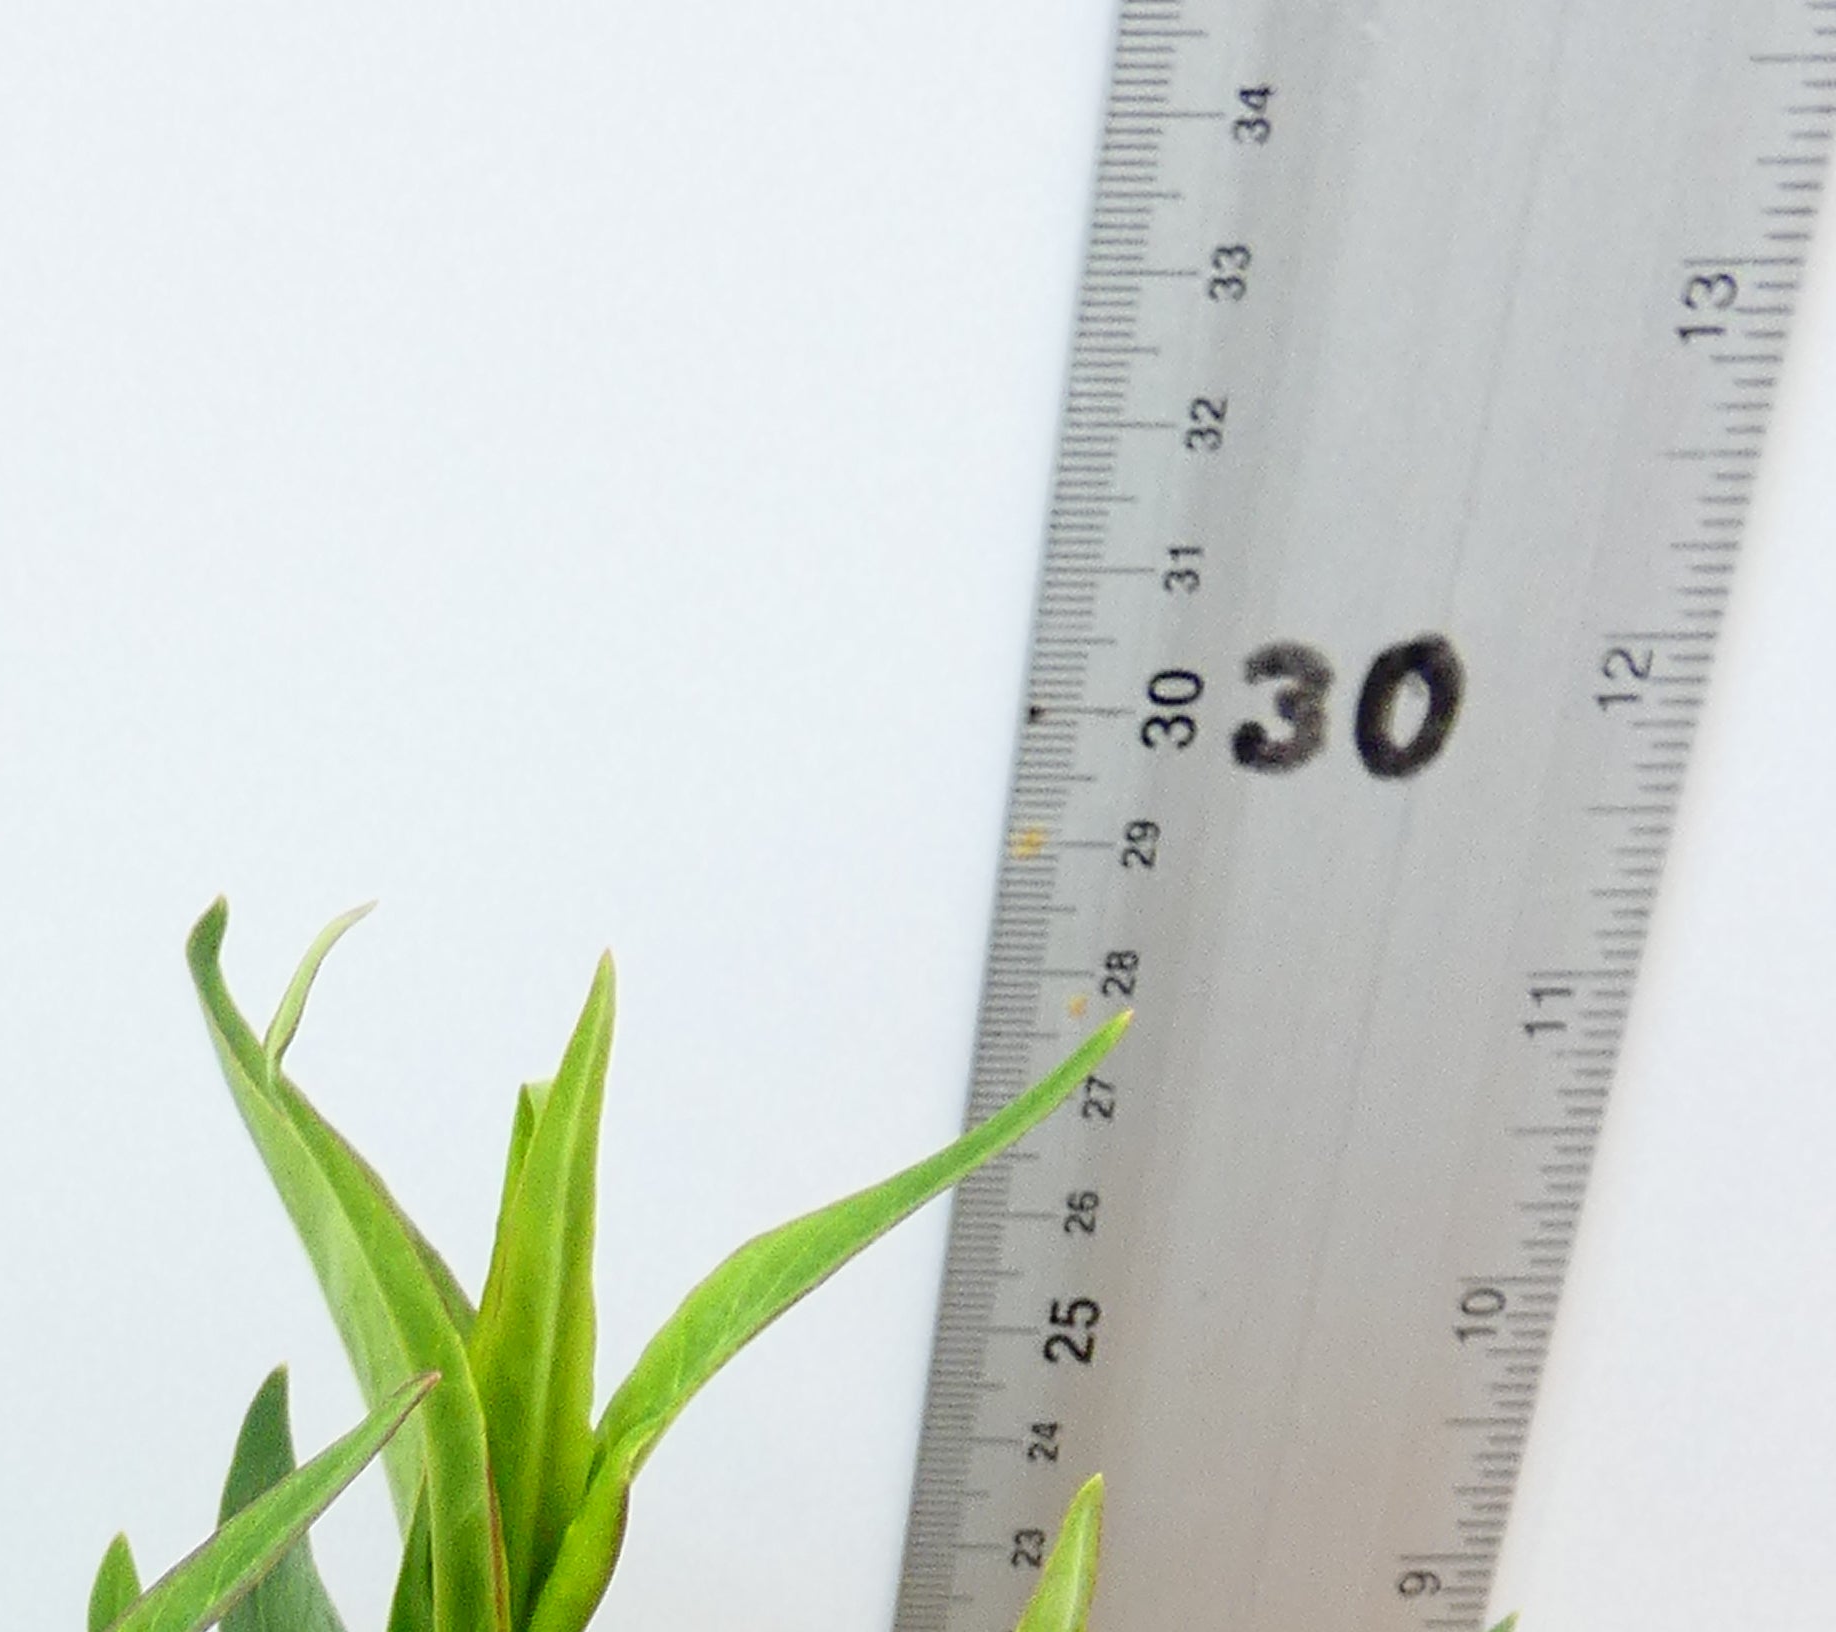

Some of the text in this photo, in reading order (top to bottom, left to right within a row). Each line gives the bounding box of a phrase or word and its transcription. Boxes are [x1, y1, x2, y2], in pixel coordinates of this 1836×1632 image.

[1233, 85, 1275, 144] 34
[1209, 243, 1252, 304] 33
[1677, 271, 1739, 345] 13
[1186, 397, 1228, 451] 32
[1165, 543, 1205, 594] 31
[1595, 647, 1655, 712] 12
[1141, 667, 1205, 750] 30
[1231, 633, 1467, 781] 30
[1121, 819, 1162, 871] 29
[1102, 949, 1140, 997] 28
[1524, 987, 1573, 1037] 11
[1083, 1076, 1115, 1120] 27
[1065, 1191, 1100, 1234] 26
[1044, 1296, 1101, 1365] 25
[1455, 1287, 1507, 1343] 10
[1027, 1423, 1059, 1463] 24
[1012, 1528, 1046, 1568] 23
[1400, 1572, 1441, 1596] 9
